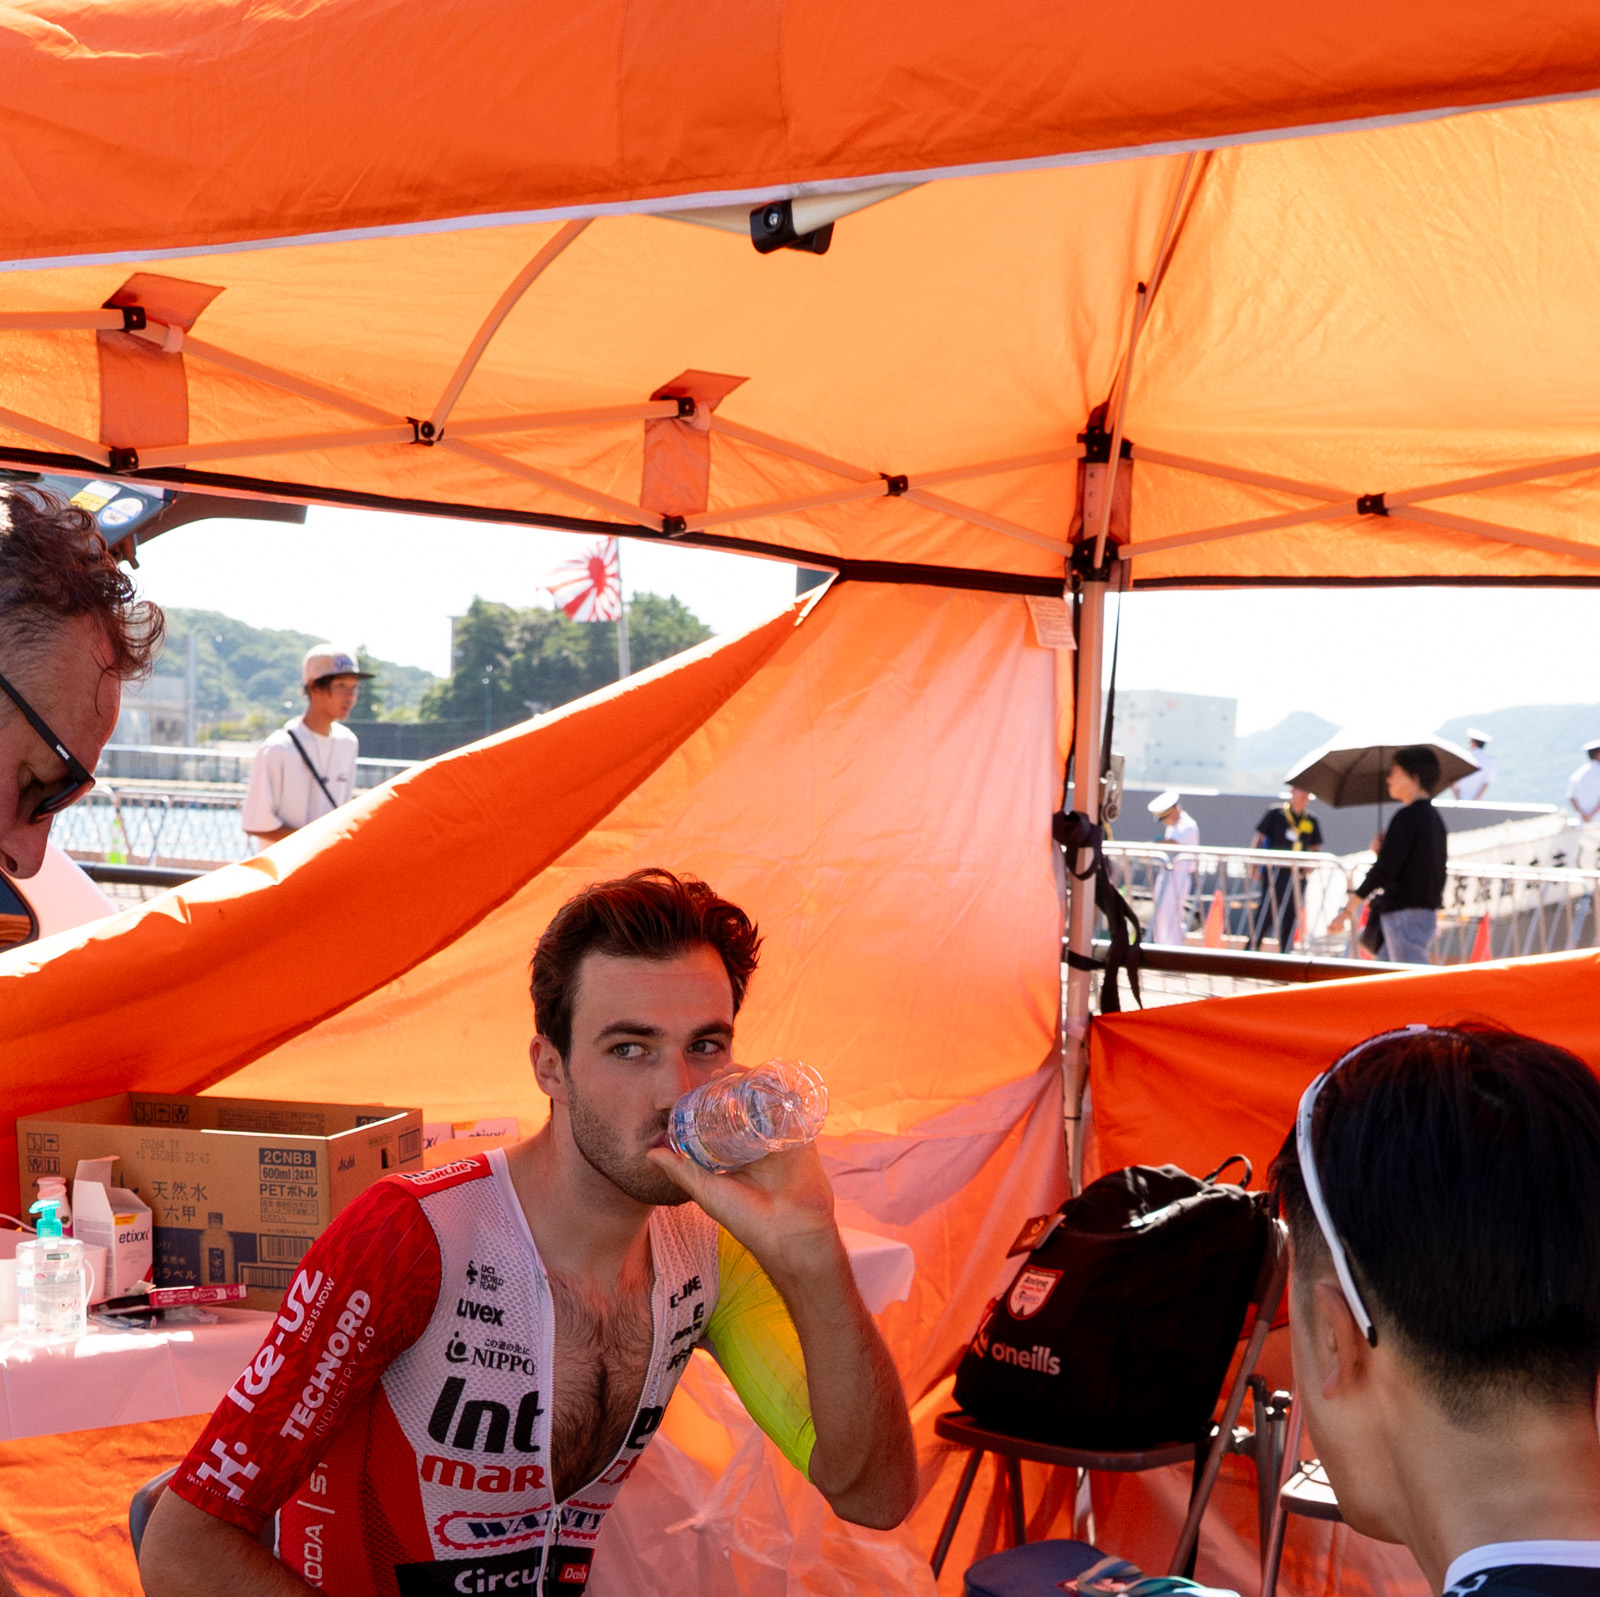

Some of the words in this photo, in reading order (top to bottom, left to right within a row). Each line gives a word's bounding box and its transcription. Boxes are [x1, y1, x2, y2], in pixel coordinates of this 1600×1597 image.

[263, 1150, 312, 1165] 2CNB8
[262, 1167, 291, 1180] 600ml
[294, 1169, 315, 1181] 24本入
[152, 1181, 208, 1201] 天然水
[259, 1184, 318, 1198] PETボトル
[163, 1205, 196, 1222] 六甲
[480, 1264, 496, 1275] UCI
[480, 1272, 505, 1286] WORLD
[480, 1281, 498, 1292] TEAM
[315, 1276, 336, 1308] NOW
[310, 1306, 321, 1318] IS
[456, 1298, 505, 1327] uvex
[300, 1317, 318, 1344] LESS
[226, 1268, 324, 1414] Re-UZ
[483, 1339, 531, 1356] この道の先に
[279, 1289, 372, 1442] TECHNORD
[471, 1347, 536, 1376] NIPPO
[313, 1358, 358, 1438] INDUSTRY
[356, 1324, 376, 1354] 4.0
